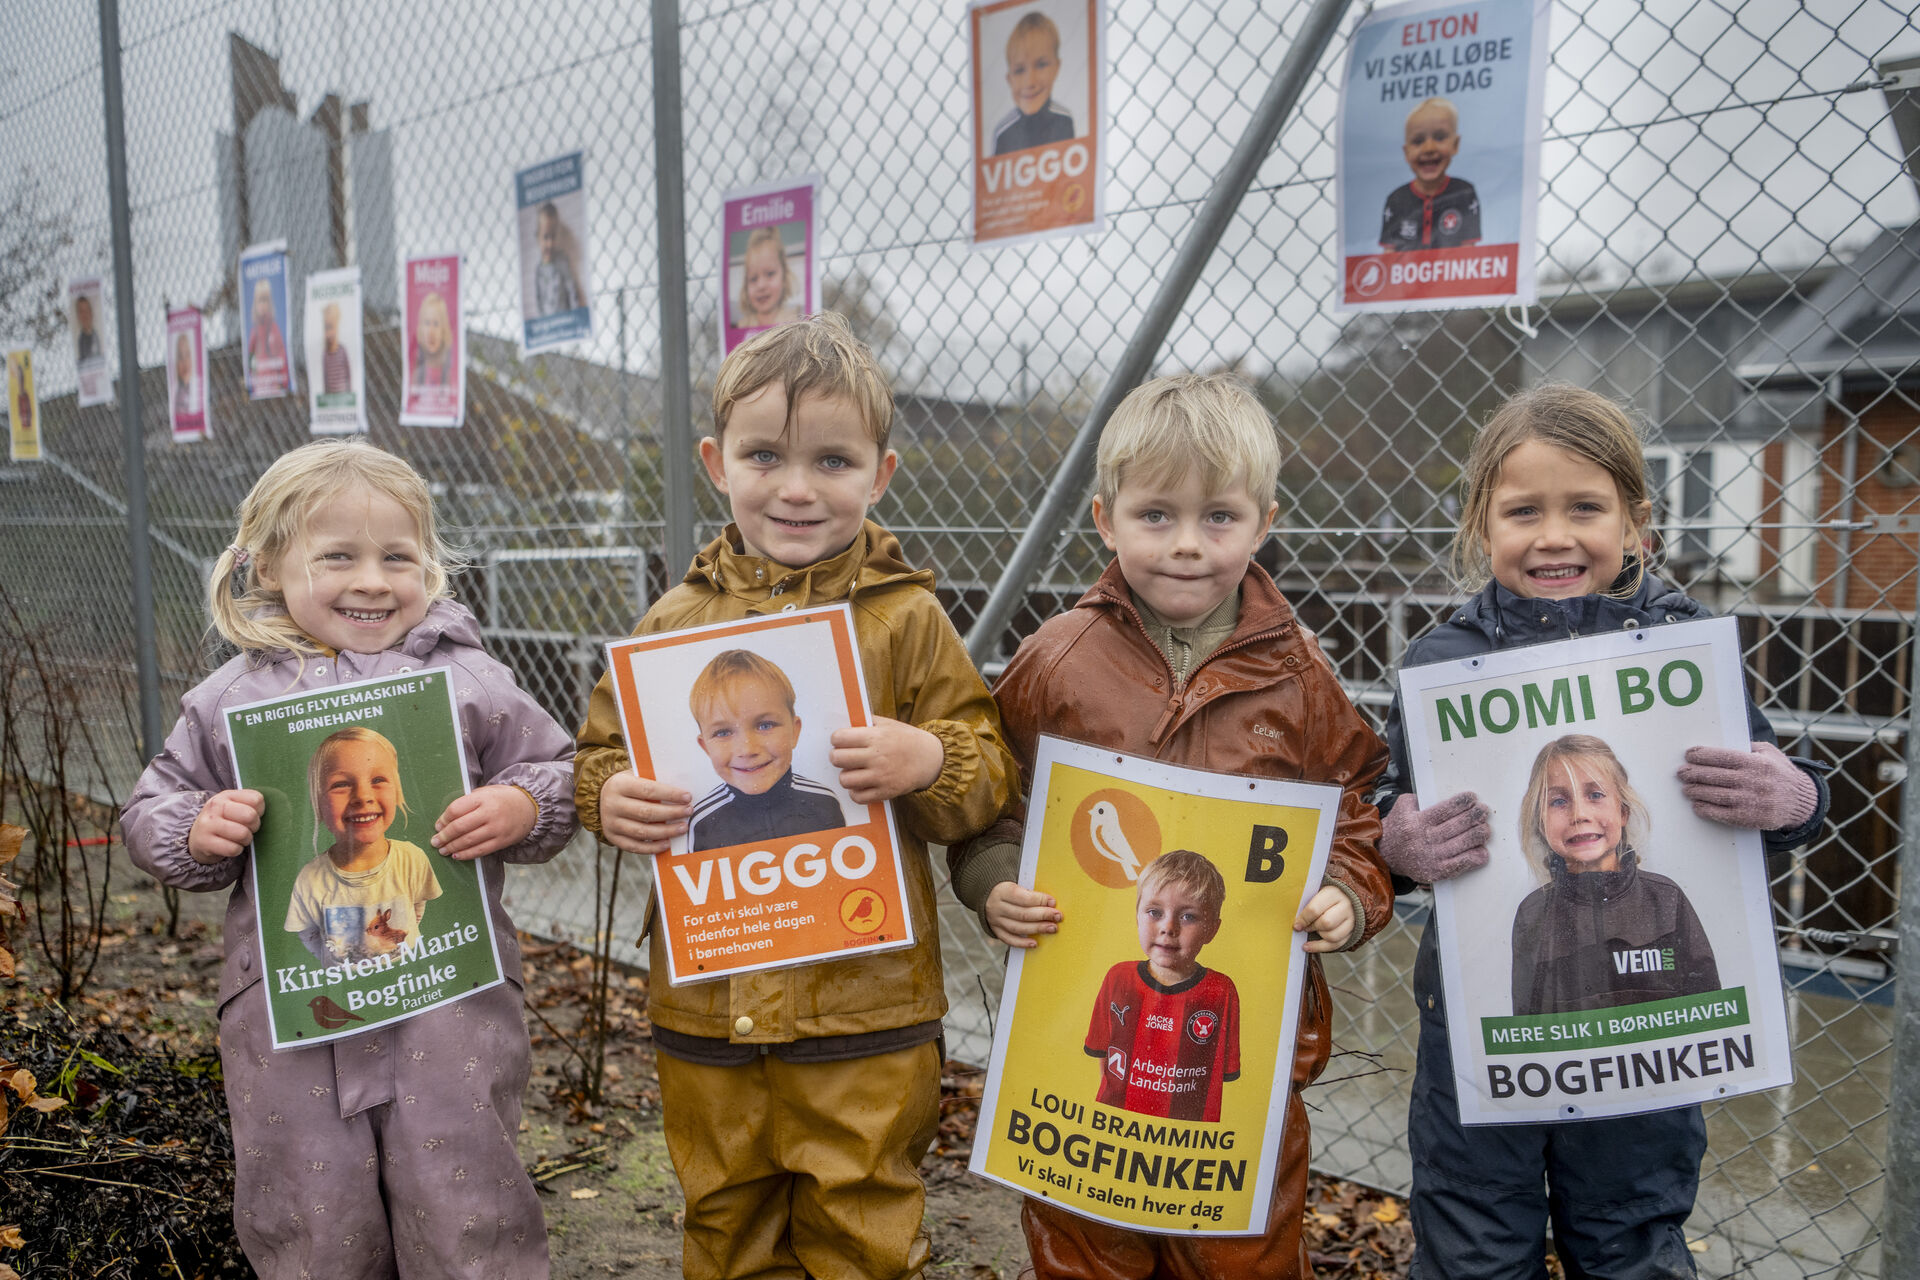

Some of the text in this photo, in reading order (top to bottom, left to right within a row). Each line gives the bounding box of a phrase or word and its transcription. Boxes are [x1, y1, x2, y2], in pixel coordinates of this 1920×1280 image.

[1402, 12, 1479, 46] ELTON
[1366, 37, 1512, 80] VI SKAL LØBE
[1381, 67, 1492, 102] HVER DAG
[981, 143, 1089, 193] VIGGO
[741, 200, 795, 227] Emilie
[1390, 257, 1508, 285] BOGFINKEN
[245, 680, 425, 726] EN RIGTIG FLYVEMASKINE I
[1435, 659, 1704, 742] NOMI BO
[287, 704, 384, 734] BØRNEHAVEN
[672, 835, 877, 906] VIGGO
[1244, 824, 1289, 884] B
[683, 899, 799, 928] For at vi skal være
[686, 912, 815, 945] indenfor hele dagen
[276, 921, 480, 995] Kirsten Marie
[695, 936, 774, 959] børnehaven
[844, 933, 894, 949] BOGFINEN
[1613, 948, 1662, 975] VEM
[346, 963, 458, 1013] Bogfinke
[401, 987, 445, 1011] Partiet
[1145, 1020, 1174, 1032] JONES
[1146, 1013, 1174, 1026] JACK&
[1491, 999, 1738, 1044] MERE SLIK I BØRNEHAVEN
[1132, 1057, 1208, 1079] Arbejdernes
[1487, 1033, 1756, 1099] BOGFINKEN
[1129, 1073, 1197, 1094] Landsbank
[1031, 1087, 1236, 1150] LOUI BRAMMING
[1006, 1108, 1248, 1192] BOGFINKEN
[1018, 1155, 1225, 1222] Vi skal i salen hver dag
